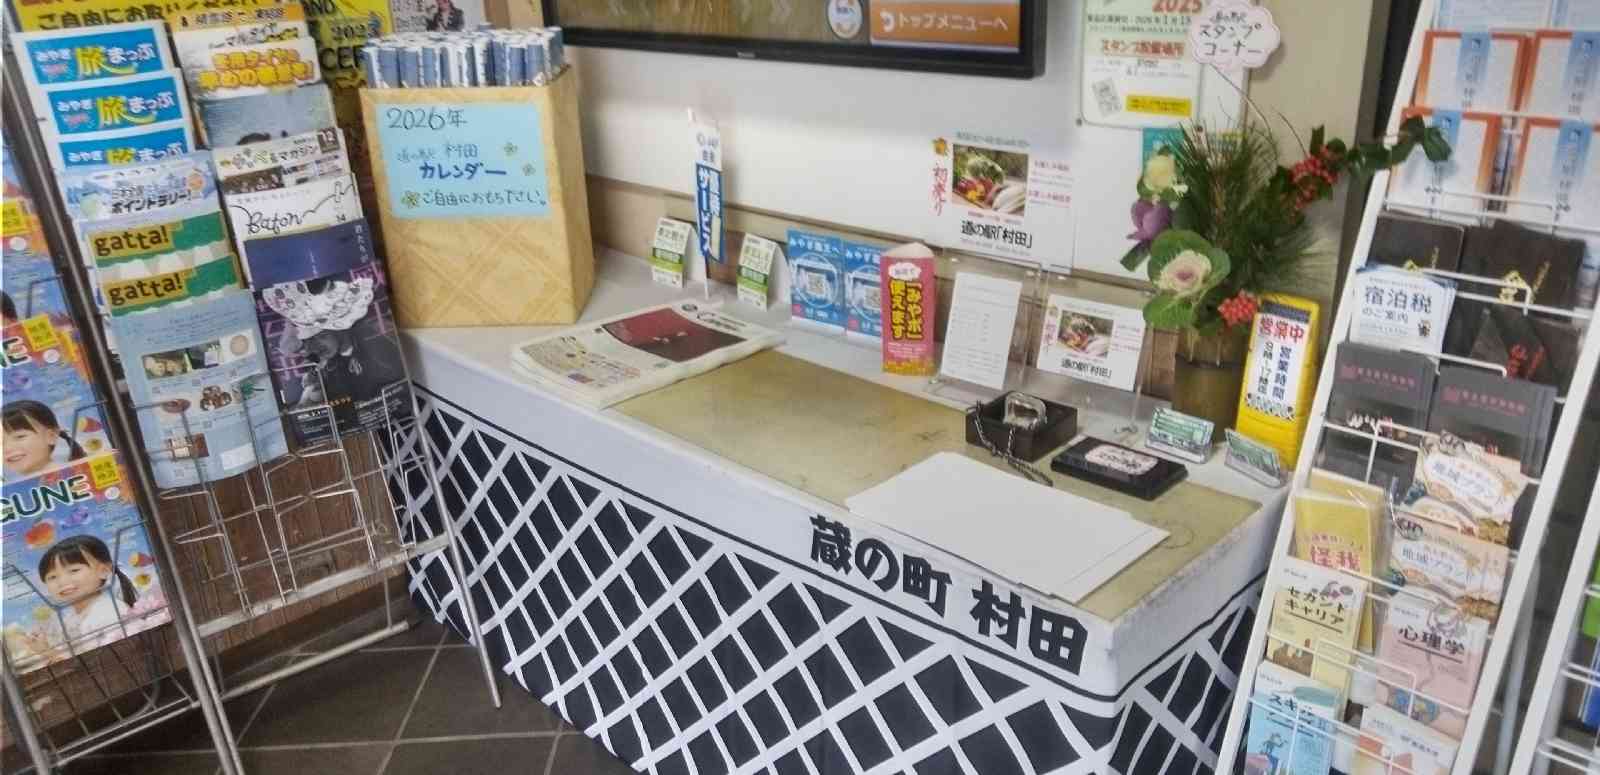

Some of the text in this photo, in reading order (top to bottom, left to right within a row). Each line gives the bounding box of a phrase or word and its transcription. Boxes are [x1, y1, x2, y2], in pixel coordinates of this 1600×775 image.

[899, 12, 1009, 31] トップメニューへ
[1199, 23, 1262, 39] スタンプ
[1203, 40, 1262, 56] コーナー
[386, 107, 468, 131] 2026年
[445, 142, 480, 159] 村田
[419, 161, 507, 180] カレンダー
[94, 224, 170, 255] gatta!
[961, 219, 1033, 249] 道の駅「村田」
[108, 271, 184, 304] gatta!
[1365, 286, 1432, 314] 宿泊税
[890, 279, 906, 340] 使えます
[1362, 308, 1409, 322] のご案内
[1259, 314, 1305, 344] 営業中
[809, 514, 1089, 676] 蔵の町 村田
[1286, 584, 1346, 612] セカンド
[1284, 598, 1345, 625] キャリア
[1398, 627, 1465, 656] 心理学
